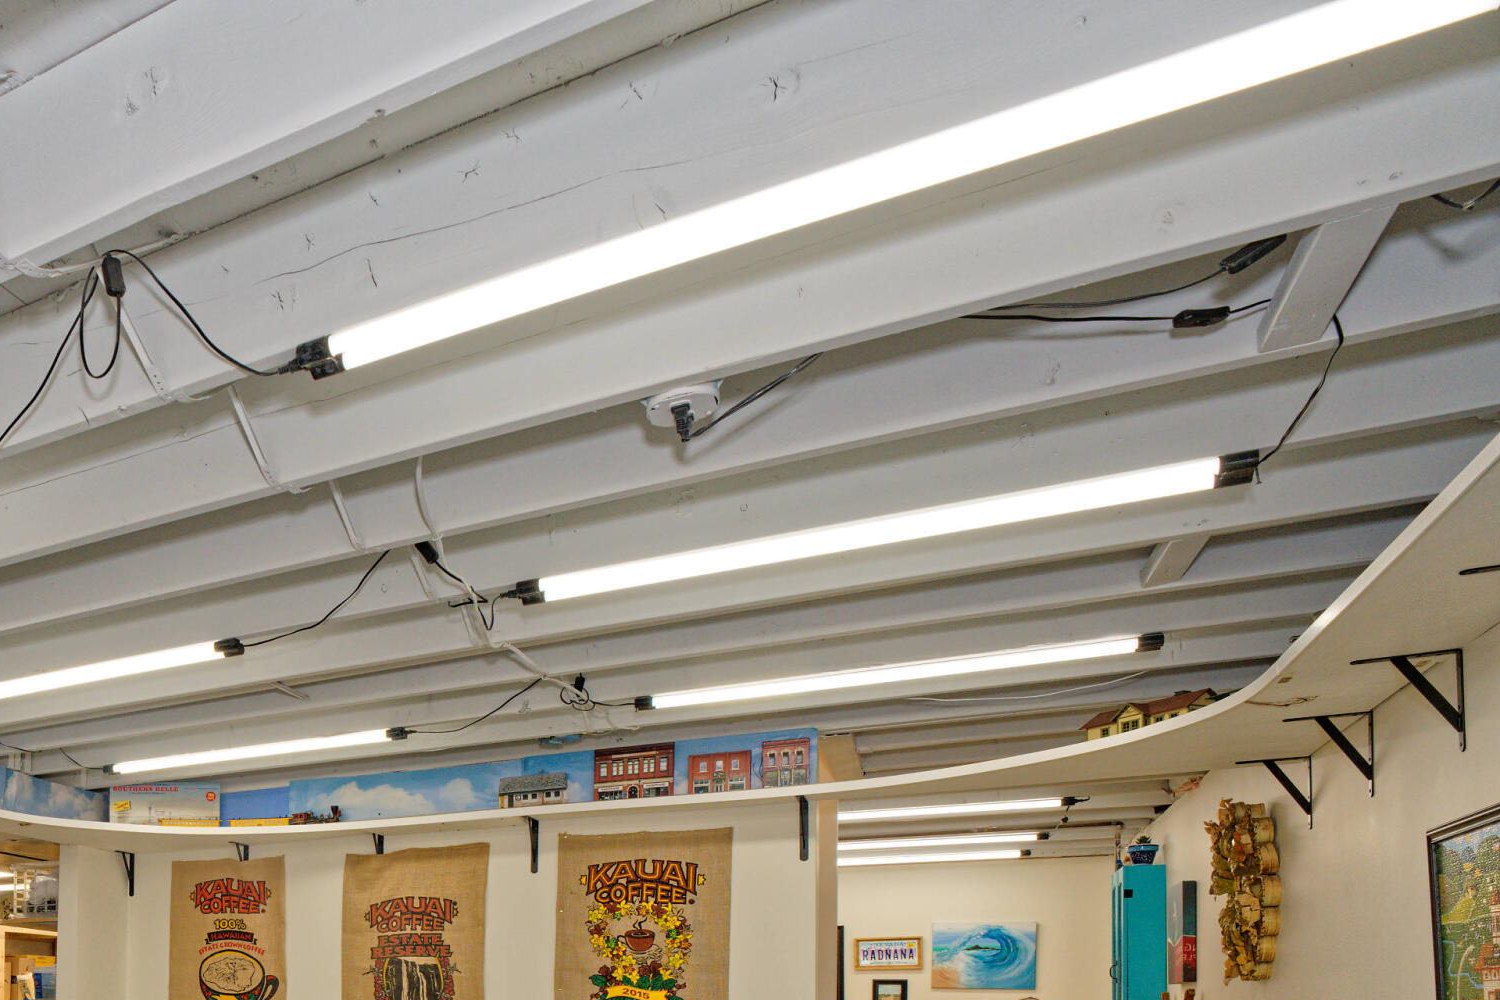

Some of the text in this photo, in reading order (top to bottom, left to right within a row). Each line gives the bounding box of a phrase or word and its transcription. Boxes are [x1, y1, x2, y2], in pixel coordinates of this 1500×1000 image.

[586, 858, 699, 896] KAUAI
[195, 878, 267, 908] KAUAI
[595, 881, 688, 904] COFFEE
[200, 894, 261, 914] COFFEE
[369, 896, 453, 928] KAUAI
[213, 918, 247, 930] 100%
[377, 912, 445, 933] COFFEE
[210, 932, 252, 940] HAWAIIAN
[377, 933, 444, 947] ESTATE
[370, 944, 453, 959] RESERVE
[862, 948, 914, 961] RADNANA
[622, 987, 650, 1000] 2015
